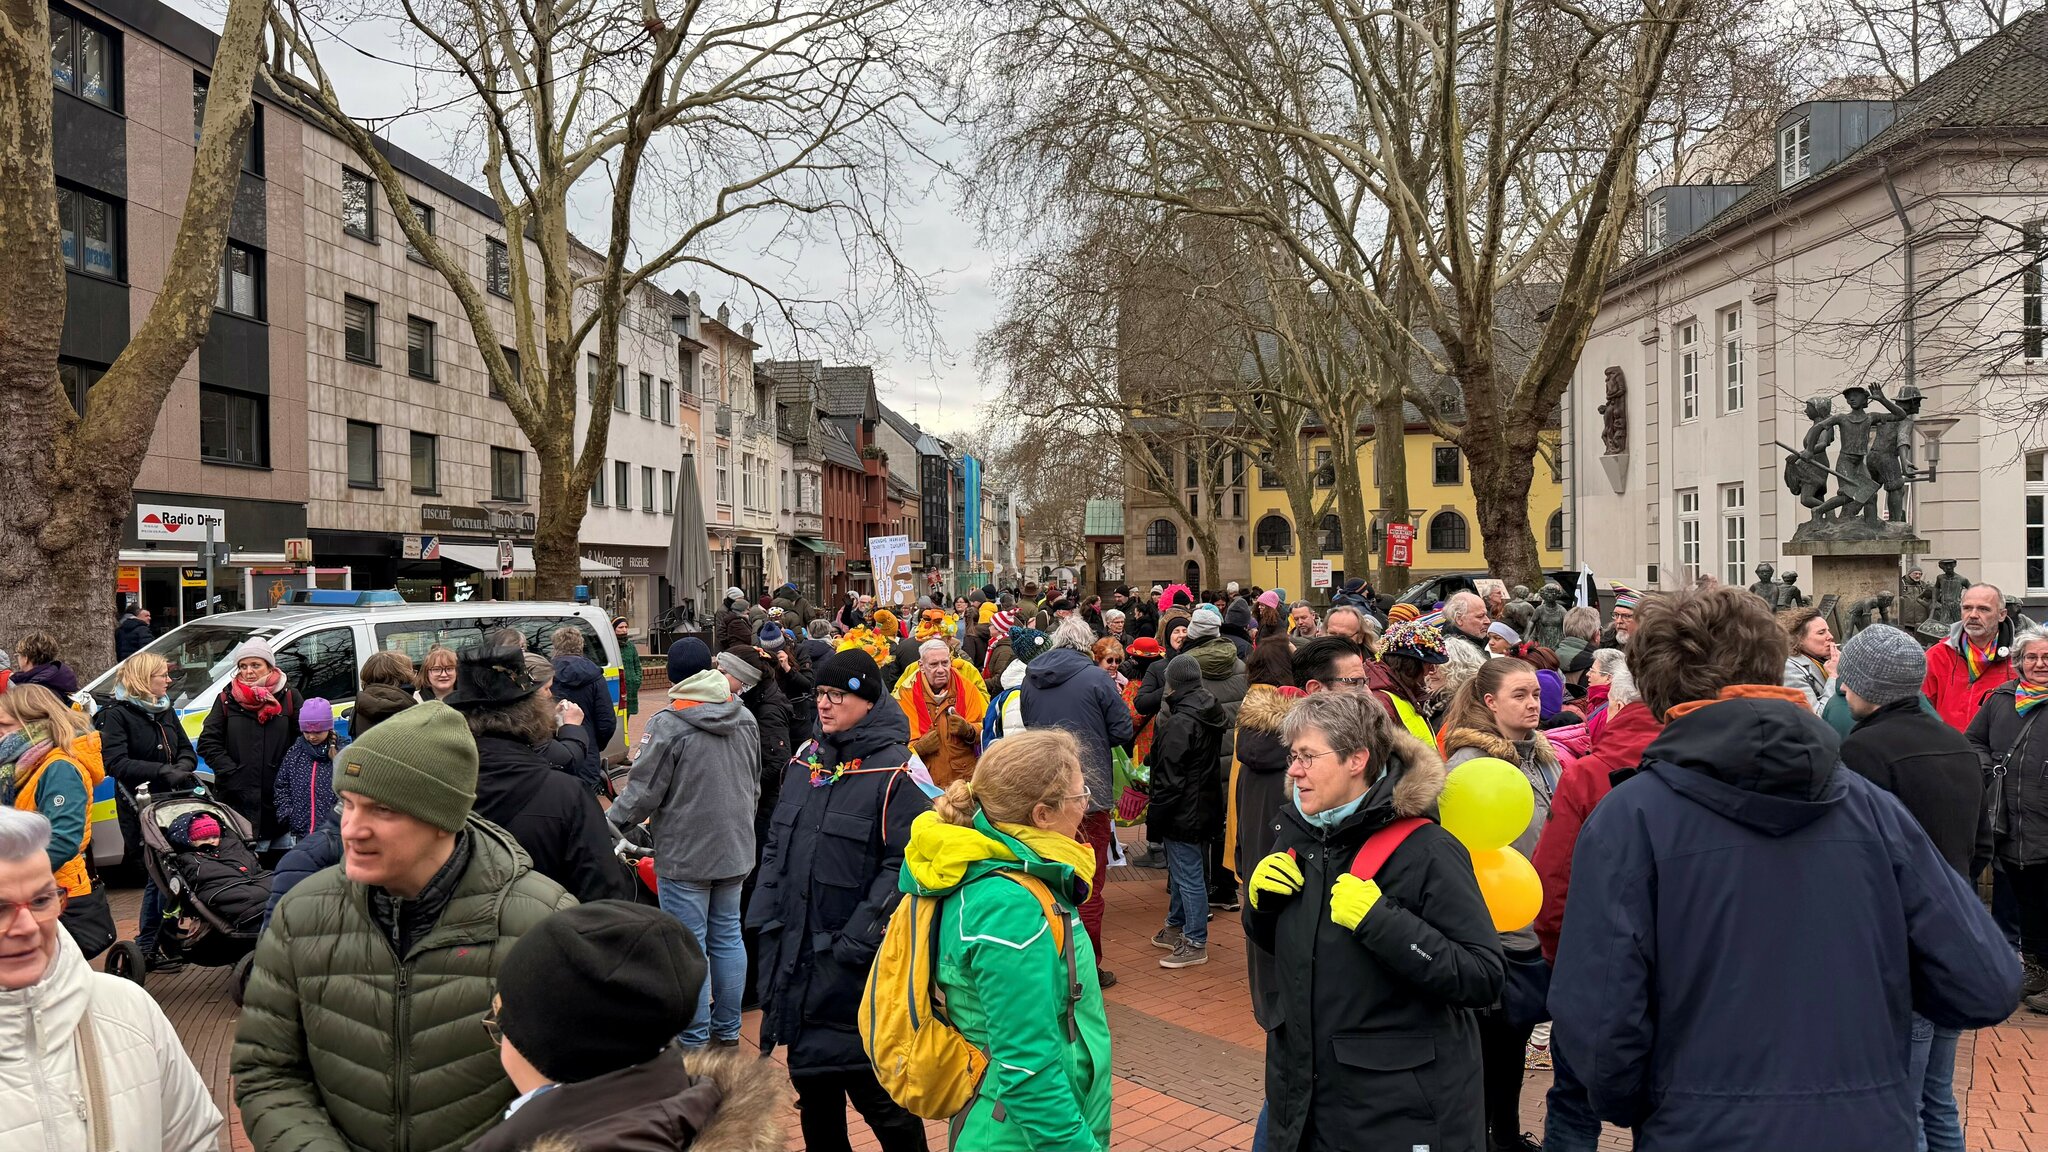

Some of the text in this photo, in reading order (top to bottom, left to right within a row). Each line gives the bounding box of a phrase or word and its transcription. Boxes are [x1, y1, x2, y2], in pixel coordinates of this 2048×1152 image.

[162, 511, 222, 527] Radio Dier
[423, 507, 451, 520] EISCAFÉ
[452, 518, 483, 530] COCKTAIL
[287, 541, 303, 560] T
[593, 550, 624, 567] Wagner
[629, 557, 649, 568] FRISEURE
